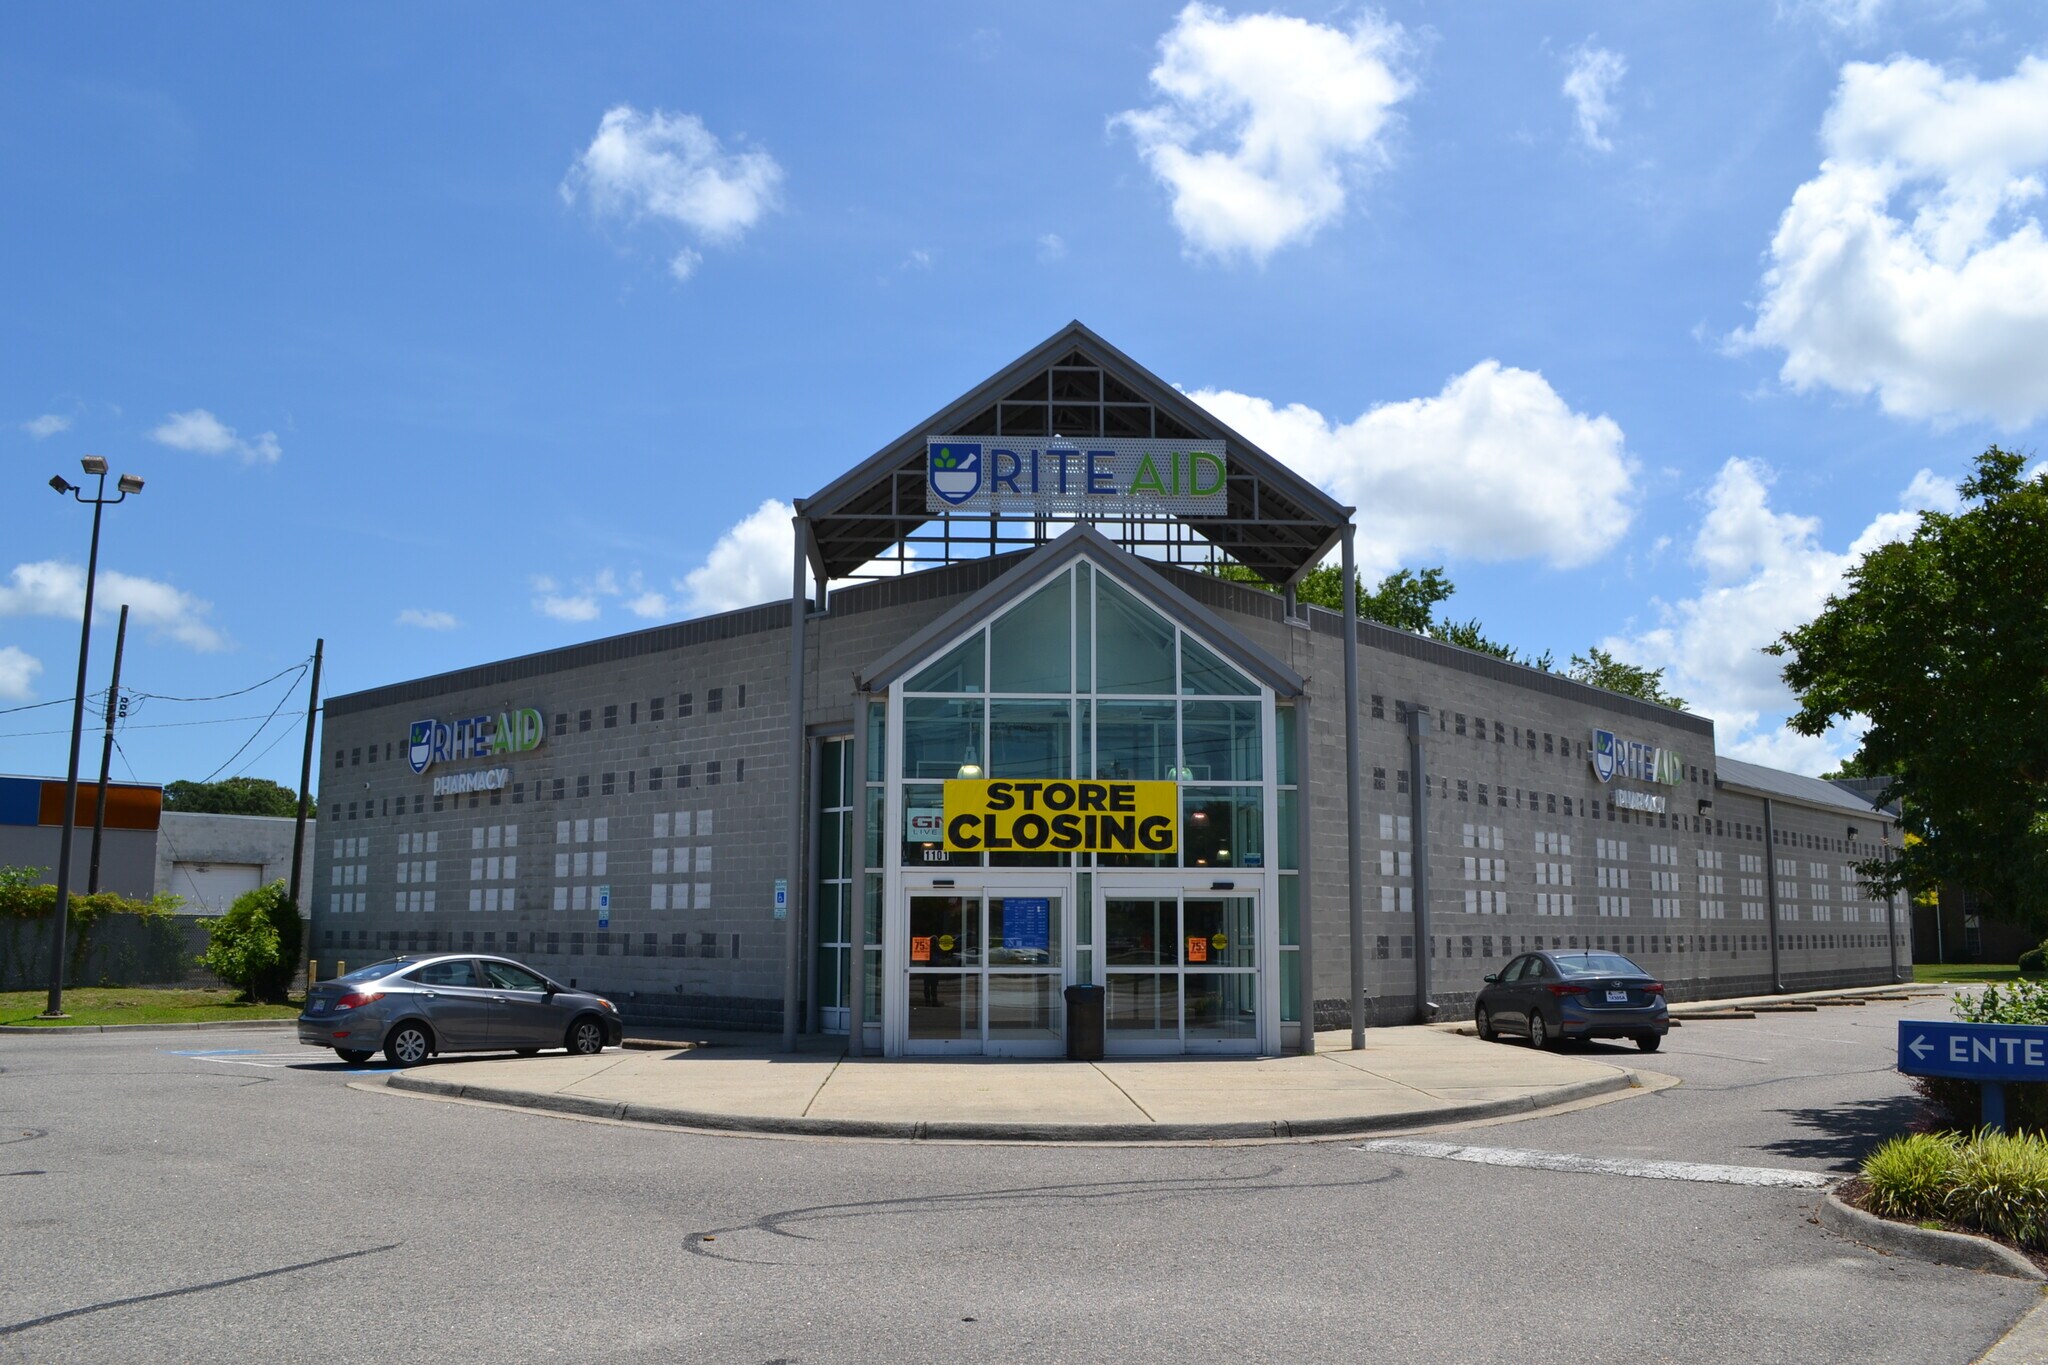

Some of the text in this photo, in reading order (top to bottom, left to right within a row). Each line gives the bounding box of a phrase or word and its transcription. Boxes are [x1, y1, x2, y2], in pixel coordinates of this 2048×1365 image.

[991, 449, 1227, 497] RITE AID
[434, 707, 543, 762] RITE AID
[1614, 738, 1682, 787] RITE AID
[433, 768, 508, 796] PHARMACY
[986, 782, 1136, 812] STORE
[948, 813, 1173, 851] CLOSING
[925, 850, 949, 861] 1101
